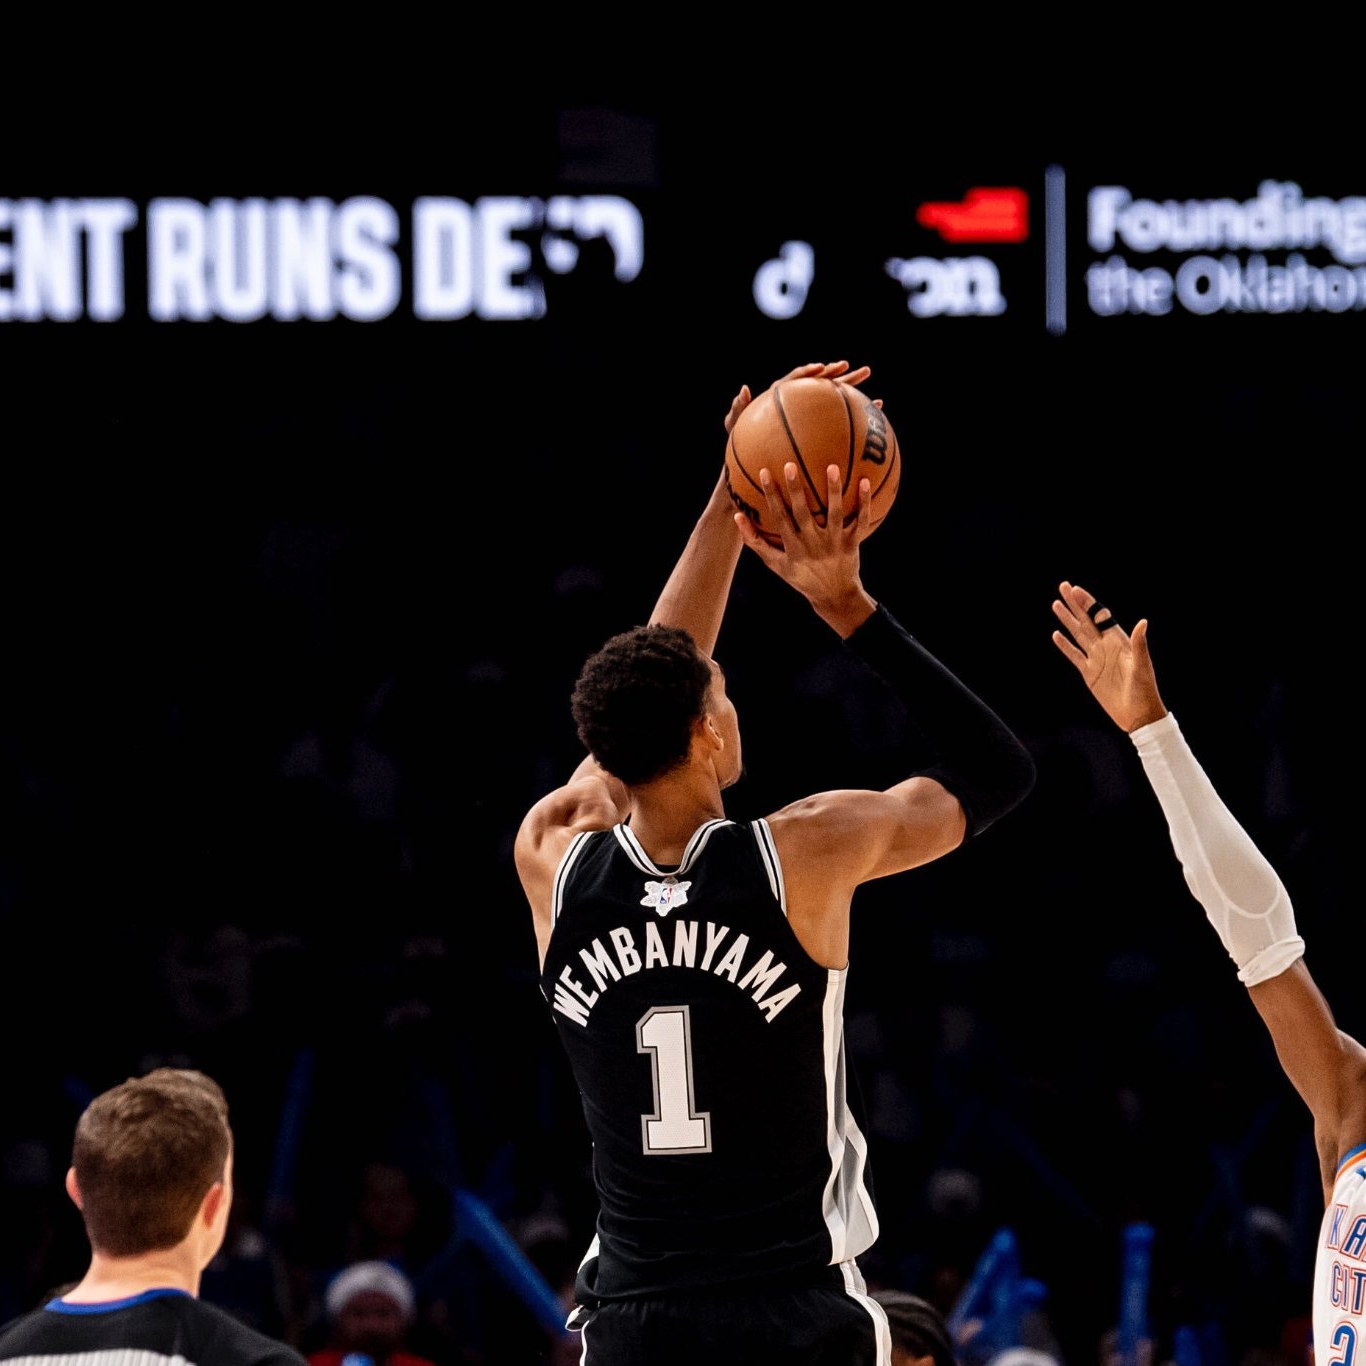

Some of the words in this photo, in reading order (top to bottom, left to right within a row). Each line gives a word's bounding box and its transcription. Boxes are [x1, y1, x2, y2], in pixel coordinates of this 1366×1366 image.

[146, 196, 402, 322] RUNS
[412, 195, 644, 321] DE
[1087, 255, 1175, 316] the
[553, 920, 801, 1027] WEMBANYAMA
[636, 1005, 712, 1155] 1
